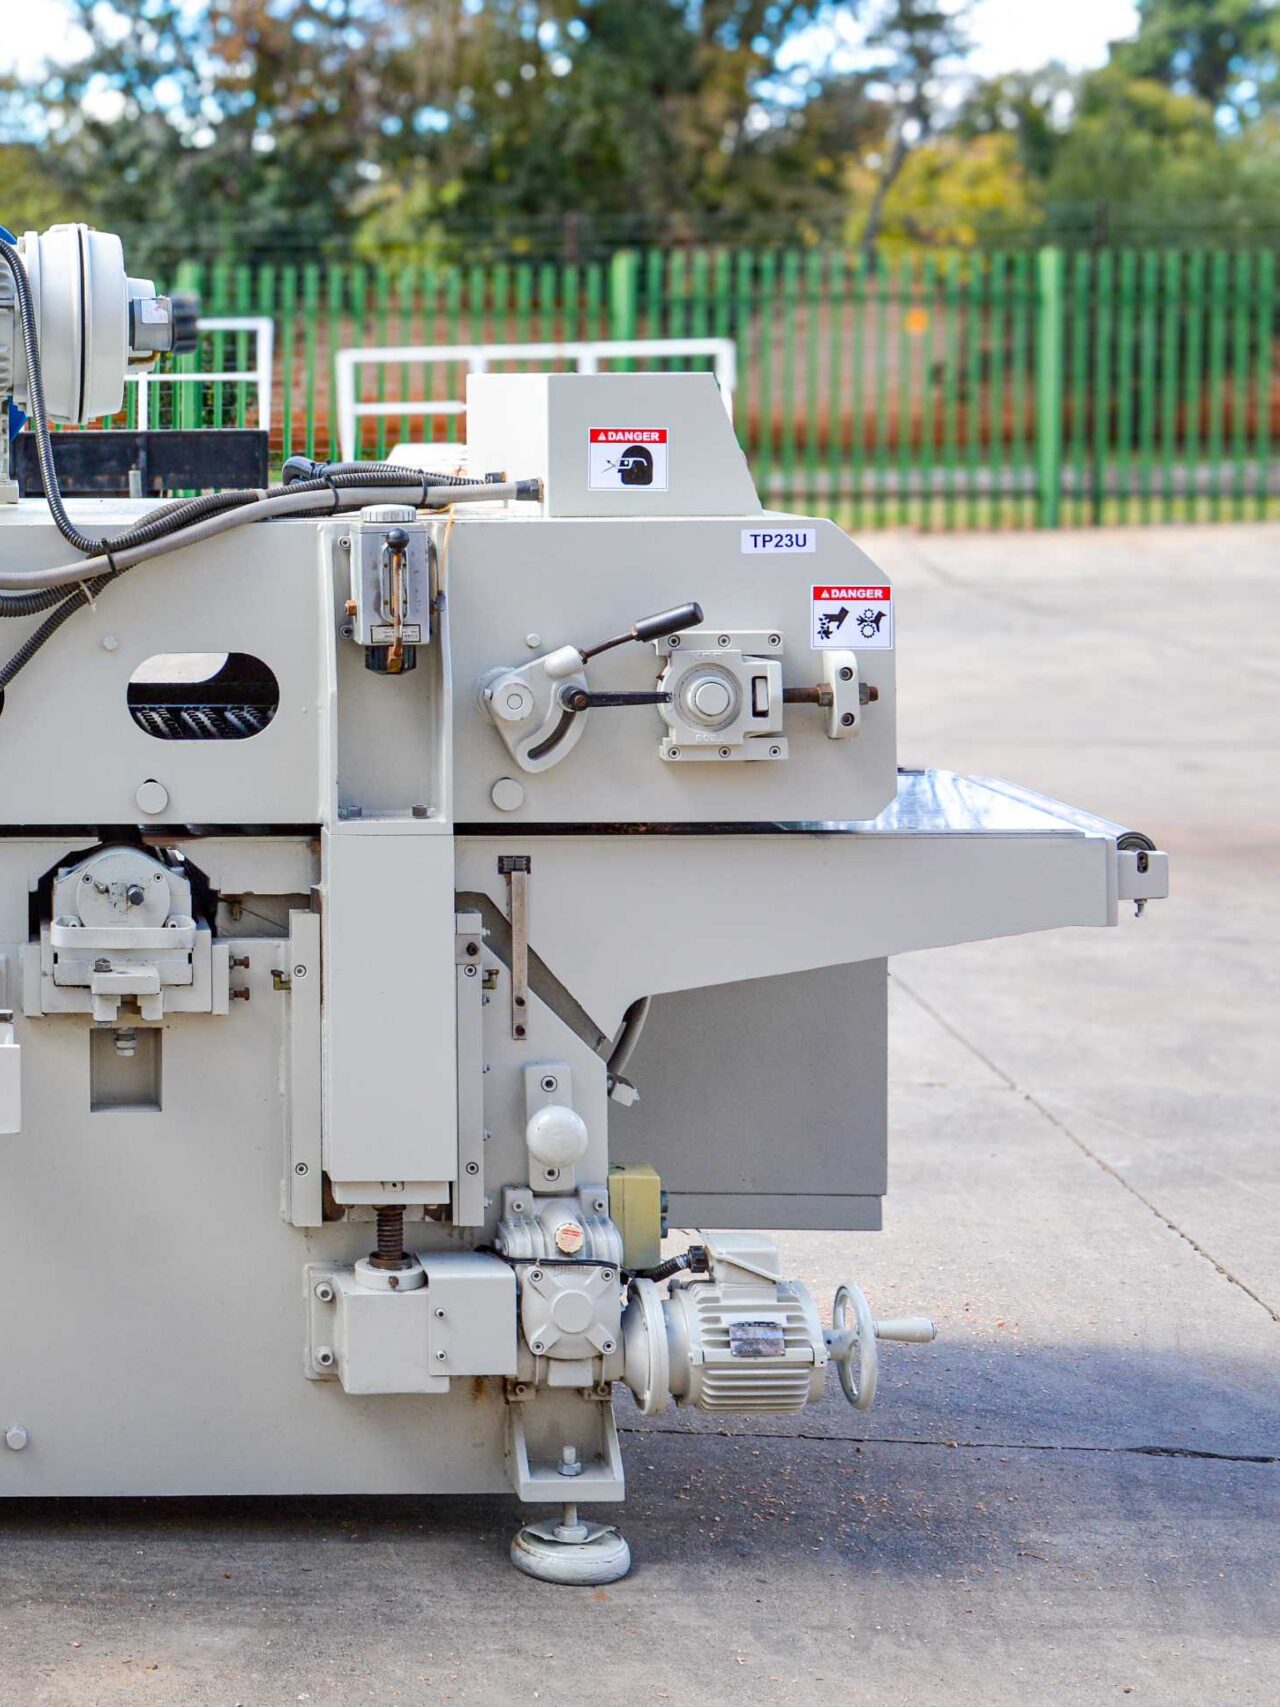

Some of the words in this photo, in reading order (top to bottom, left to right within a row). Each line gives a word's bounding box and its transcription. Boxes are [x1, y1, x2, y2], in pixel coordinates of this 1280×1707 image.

[608, 432, 660, 441] DANGER
[750, 533, 807, 548] TP23U
[831, 589, 883, 599] DANGER
